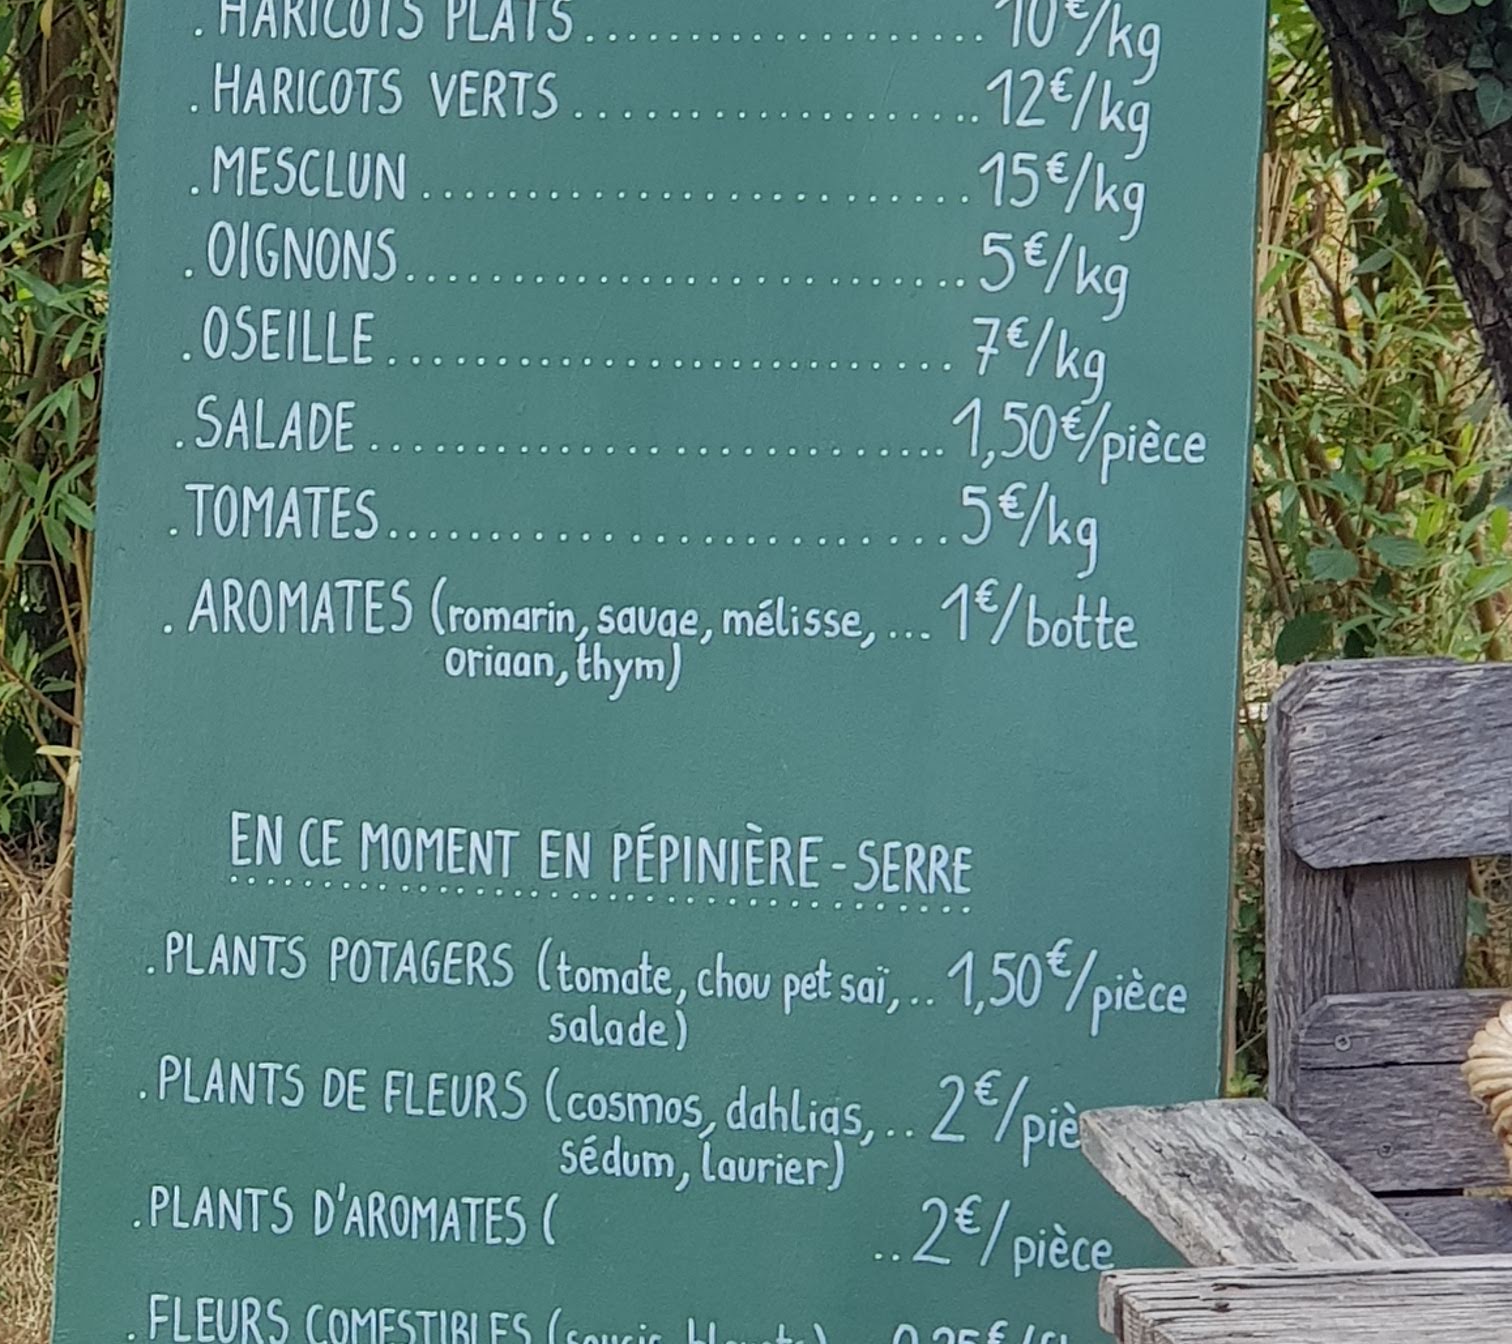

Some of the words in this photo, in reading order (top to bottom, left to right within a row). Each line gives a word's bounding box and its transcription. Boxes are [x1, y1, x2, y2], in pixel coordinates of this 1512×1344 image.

[214, 62, 403, 115] HARICOTS
[430, 69, 558, 119] VERTS
[986, 66, 1150, 160] 12€/kg
[212, 145, 406, 201] MESCLUN
[979, 151, 1145, 242] 15€/kg
[207, 220, 397, 282] OIGNONS
[979, 230, 1129, 322] 5€/kg
[203, 305, 375, 365] OSEILLE
[972, 316, 1106, 405] 7€/kg
[195, 394, 356, 452] SALADE
[952, 397, 1206, 485] 1,50€/pièce
[184, 483, 379, 540] TOMATES
[961, 481, 1098, 579] 5€/kg
[188, 578, 413, 634] AROMATES
[431, 576, 589, 643] (romarin,
[941, 577, 1138, 650] 1€/botte
[576, 641, 682, 701] thym)
[231, 810, 283, 866] EN
[299, 817, 344, 868] CE
[361, 821, 521, 878] MOMENT
[540, 829, 591, 879] EN
[613, 822, 824, 888] PÉPINIÈRE
[853, 840, 973, 894] SERRE
[166, 931, 307, 979] PLANTS
[330, 936, 514, 988] POTAGERS
[537, 936, 687, 1006] (tomate,
[697, 951, 771, 1000] chou
[783, 958, 833, 1015] pet
[947, 937, 1188, 1037] 1,50€/pièce
[548, 1004, 687, 1051] salade)
[159, 1054, 305, 1107] PLANTS
[323, 1067, 367, 1112] DE
[384, 1070, 527, 1120] FLEURS
[545, 1066, 717, 1144] (cosmos,
[559, 1134, 690, 1192] sédum,
[702, 1139, 845, 1191] laurier)
[150, 1184, 294, 1234] PLANTS
[314, 1182, 527, 1246] D'AROMATES
